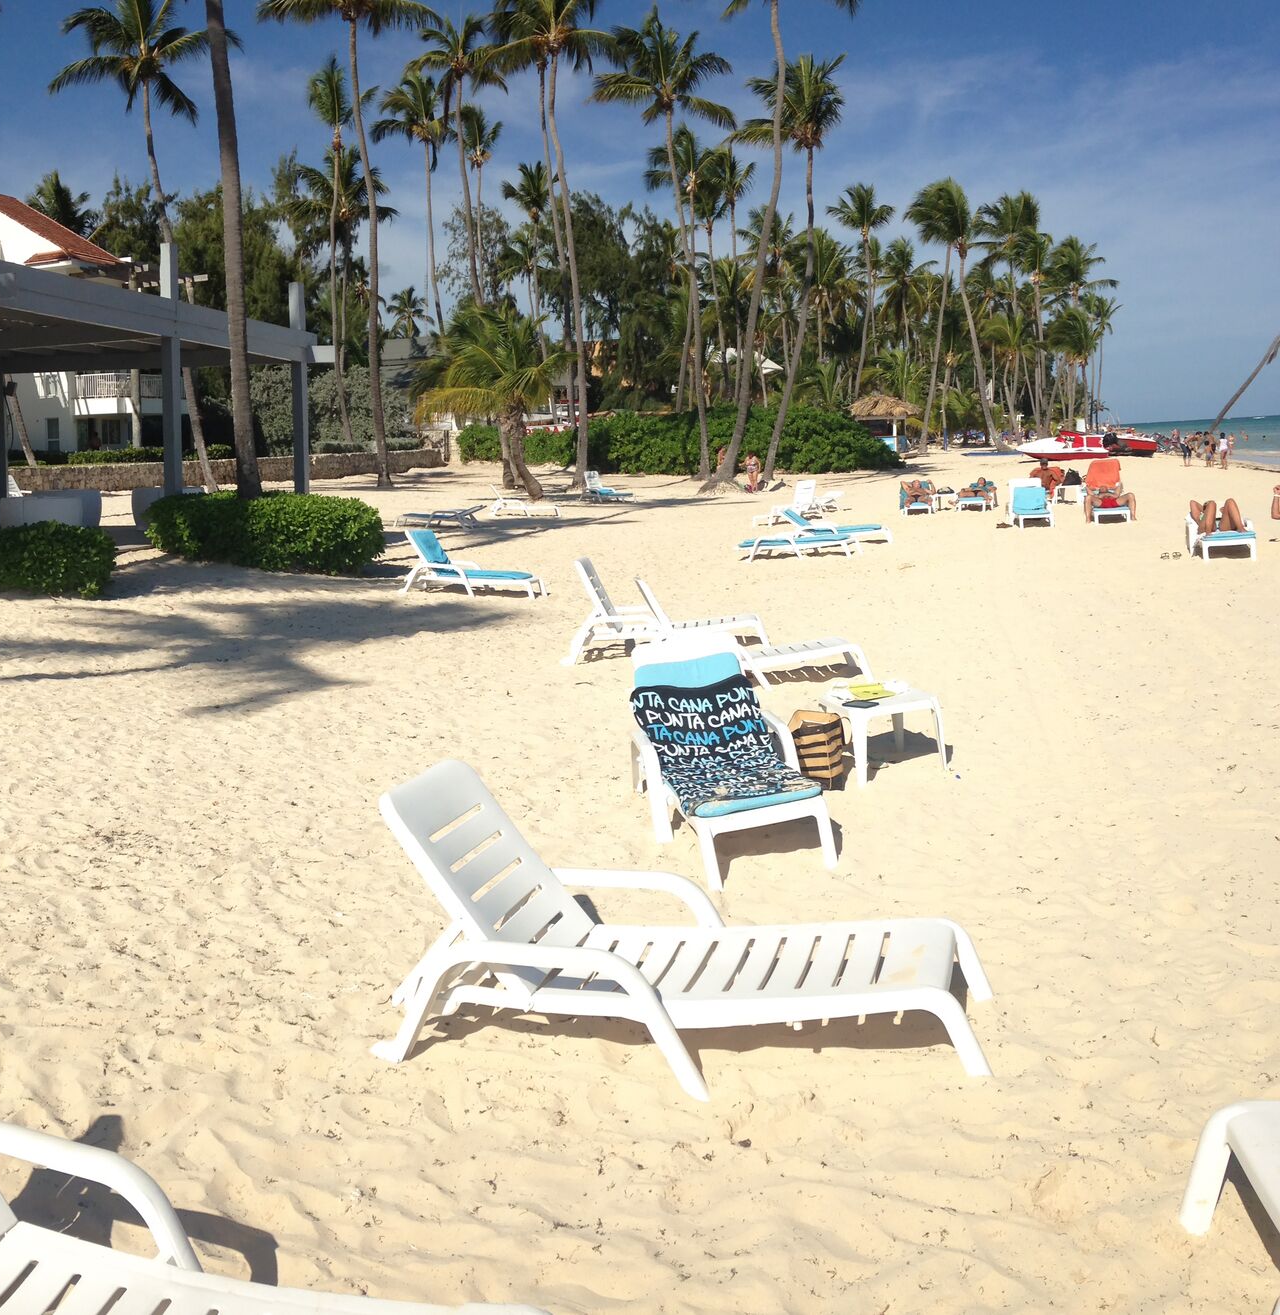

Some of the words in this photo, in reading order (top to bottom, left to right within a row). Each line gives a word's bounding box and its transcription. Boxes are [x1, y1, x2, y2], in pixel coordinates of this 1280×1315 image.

[645, 710, 705, 730] PUNTA
[708, 703, 752, 727] CANA
[668, 697, 713, 713] CANA
[652, 742, 711, 757] PUNTA
[715, 733, 758, 753] CANA
[674, 731, 720, 746] CANA
[723, 719, 765, 740] PUNT
